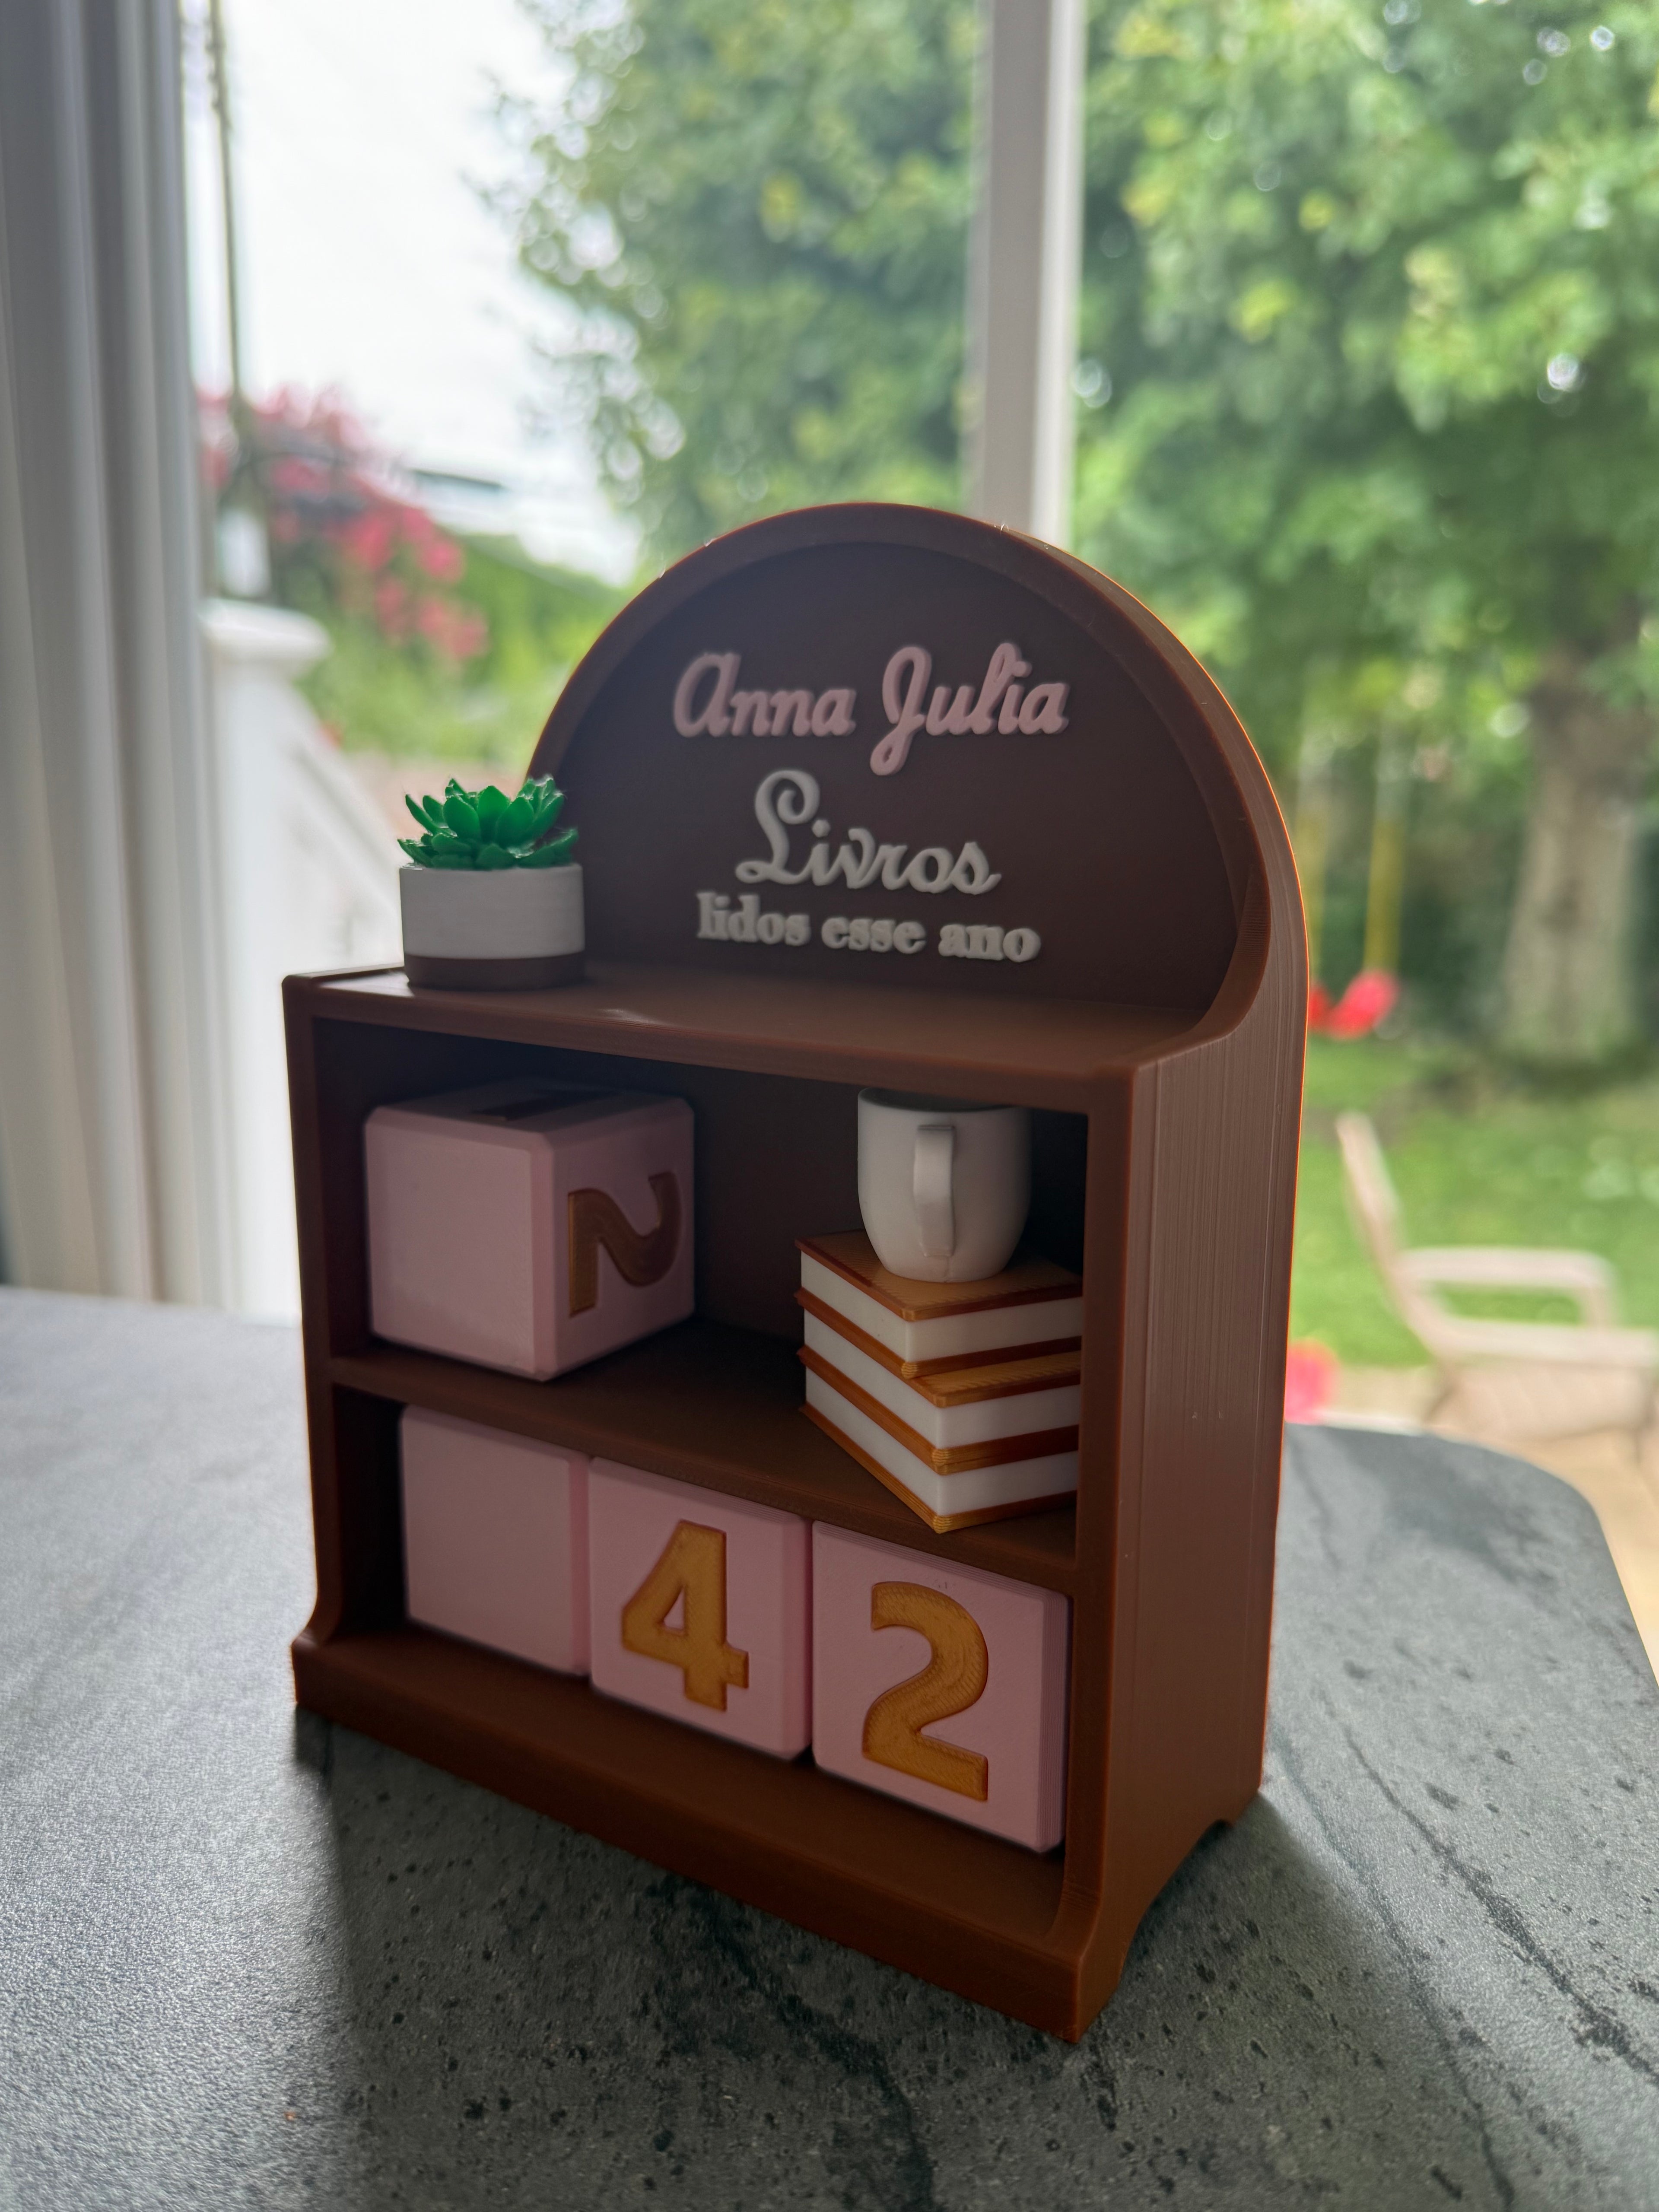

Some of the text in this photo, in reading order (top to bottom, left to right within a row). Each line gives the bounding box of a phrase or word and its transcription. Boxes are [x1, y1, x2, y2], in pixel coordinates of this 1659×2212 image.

[674, 643, 1069, 775] Anna Julia
[735, 770, 1001, 894] Livros
[696, 891, 1041, 963] lidos esse ano
[568, 1171, 680, 1317] 2
